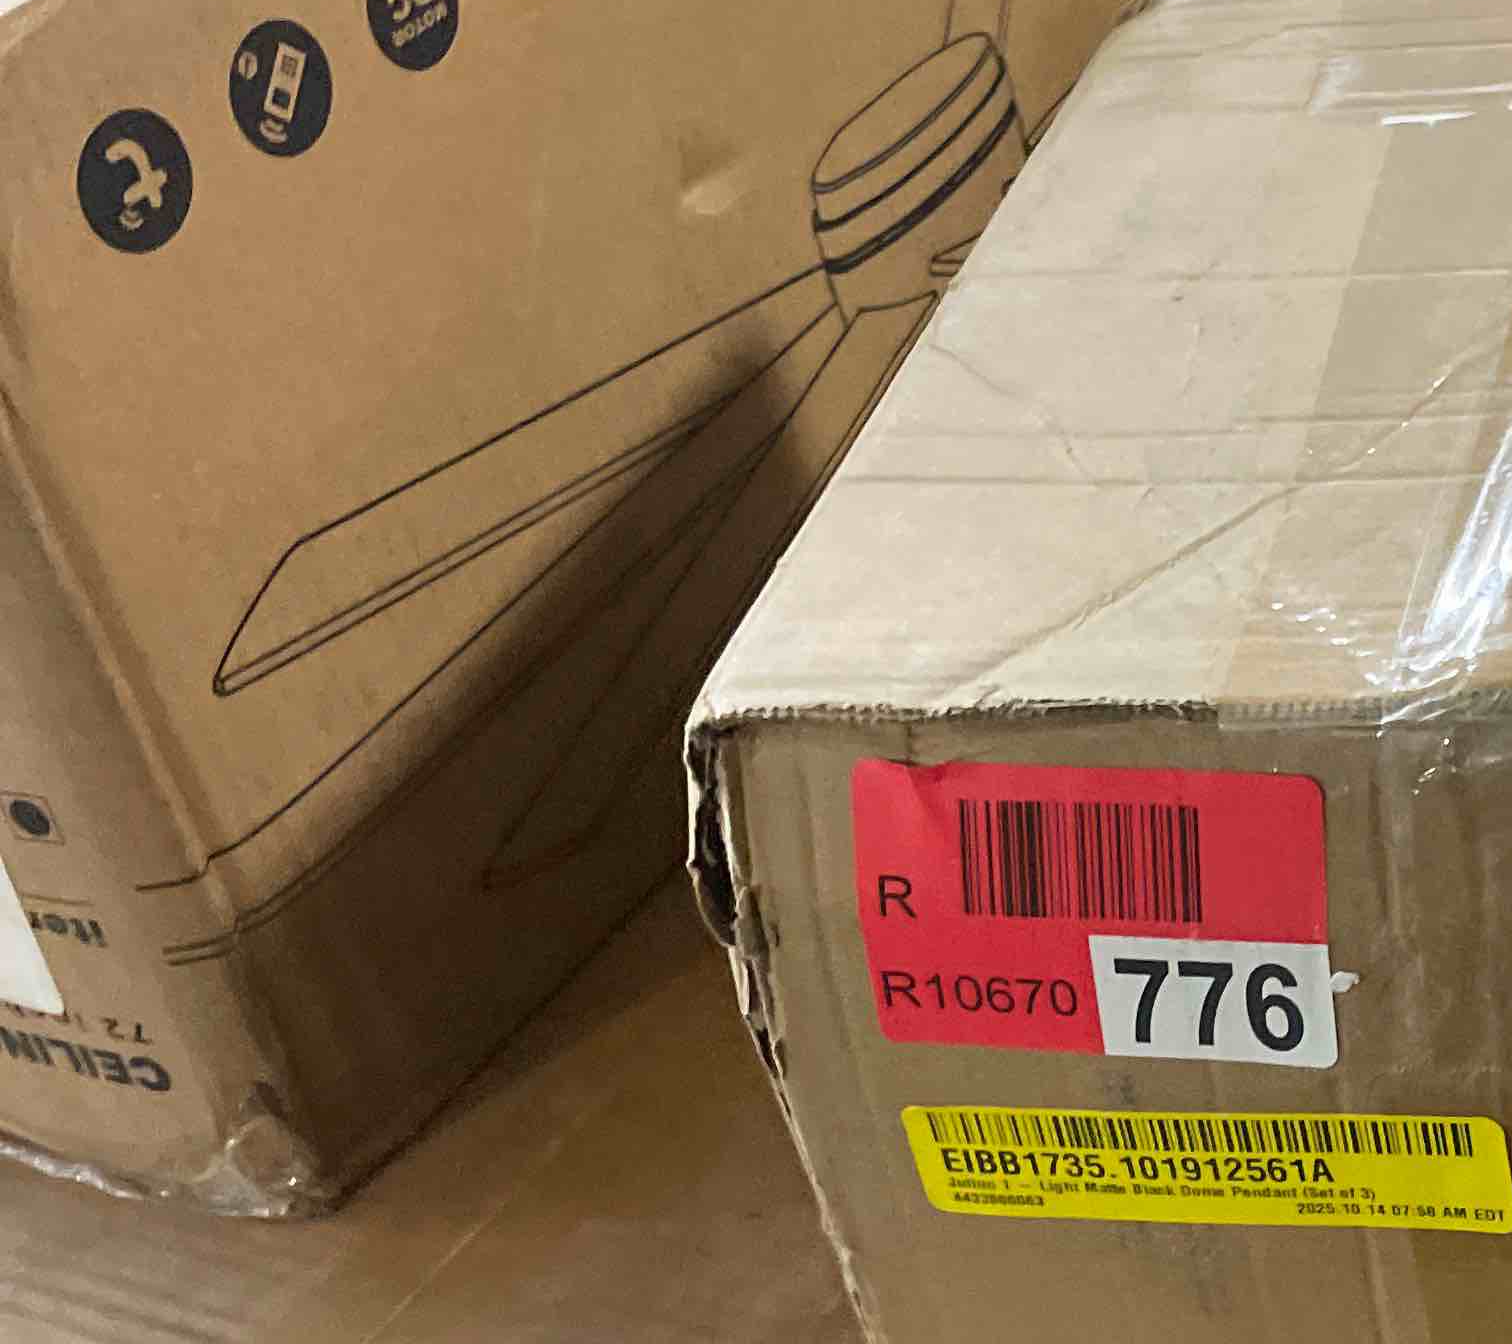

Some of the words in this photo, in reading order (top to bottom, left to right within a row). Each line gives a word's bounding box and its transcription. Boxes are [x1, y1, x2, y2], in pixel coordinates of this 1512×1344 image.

[391, 1, 448, 48] MOTOR
[877, 874, 917, 919] R
[880, 970, 1079, 1017] R10670
[1112, 957, 1305, 1053] 776
[940, 1147, 1336, 1184] EIBB1735.101912561A
[1040, 1180, 1080, 1195] Light
[1132, 1183, 1176, 1197] Black
[1231, 1185, 1297, 1199] Pendant
[1302, 1186, 1331, 1200] (Set
[1340, 1187, 1356, 1199] of
[1360, 1187, 1376, 1201] 3)
[1442, 1206, 1468, 1219] AM
[1474, 1208, 1505, 1222] EDT
